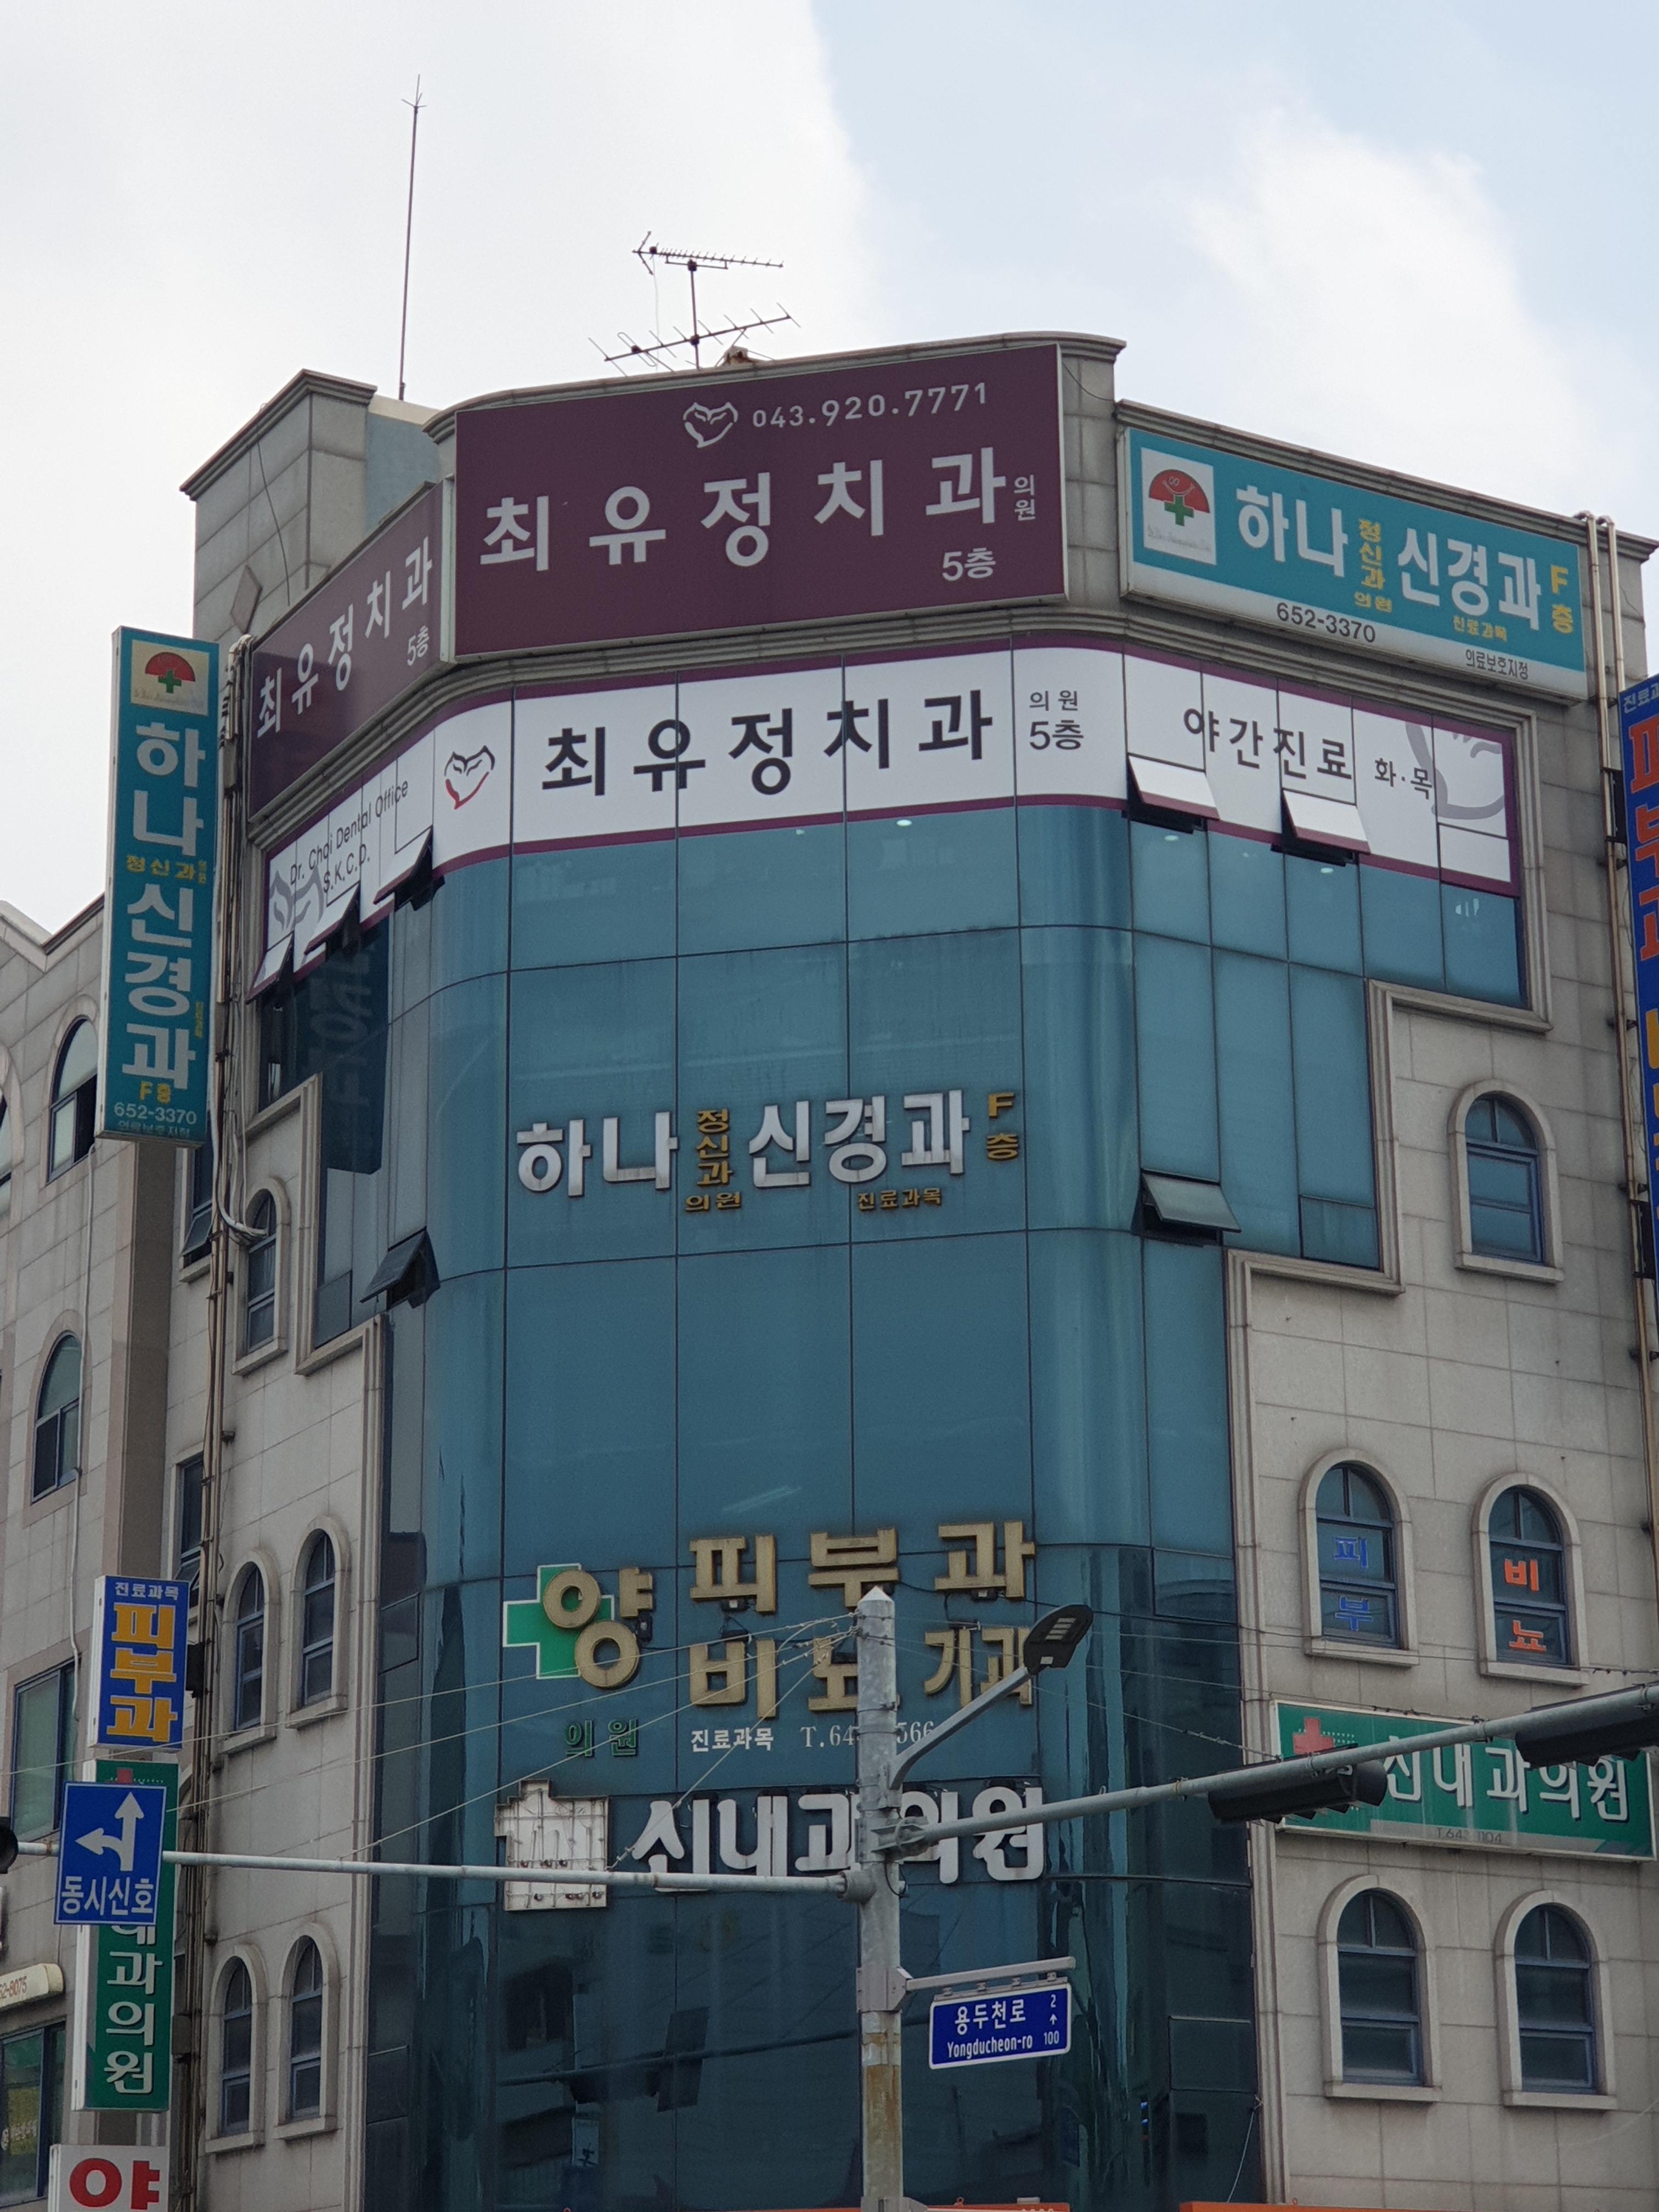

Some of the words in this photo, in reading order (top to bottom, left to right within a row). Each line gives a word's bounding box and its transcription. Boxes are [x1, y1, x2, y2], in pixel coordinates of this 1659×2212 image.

[753, 382, 988, 429] 043.920.7771
[479, 447, 1006, 571] 최유정치과
[1013, 475, 1037, 522] 의원
[942, 548, 996, 582] 5층
[1235, 485, 1349, 577] 하나
[1397, 528, 1542, 630] 신경과
[257, 535, 433, 738] 최유정치과
[407, 624, 430, 667] 5층
[1277, 602, 1377, 645] 652-3370
[1465, 648, 1528, 680] 의료보호지정
[1029, 690, 1080, 712] 의원
[541, 689, 993, 797] 최유정치과
[1029, 720, 1084, 751] 5층
[1183, 708, 1352, 780] 야간진료
[132, 721, 206, 857] 하나
[290, 863, 305, 885] Dr.
[308, 833, 332, 871] Choi
[336, 802, 371, 849] Dental
[375, 780, 408, 817] Office
[324, 843, 370, 894] S.K.C.D.
[121, 883, 196, 1090] 신경과
[114, 1101, 198, 1125] 652-3370
[516, 1111, 679, 1197] 하나
[749, 1090, 970, 1188] 신경과
[696, 1108, 732, 1187] 정신과
[685, 1192, 742, 1213] 의원
[857, 1187, 941, 1211] 진료과목
[689, 1521, 1035, 1612] 피부과
[115, 1582, 179, 1601] 진료과목
[542, 1566, 653, 1689] 양
[106, 1602, 178, 1743] 피부과
[563, 1719, 638, 1757] 의원
[690, 1727, 774, 1753] 진료과목
[61, 1876, 154, 1916] 동시신호
[955, 1999, 1026, 2036] 용두천로
[1050, 1994, 1057, 2008] 2
[947, 2034, 1033, 2060] Yongducheon-ro
[1043, 2030, 1060, 2046] 100
